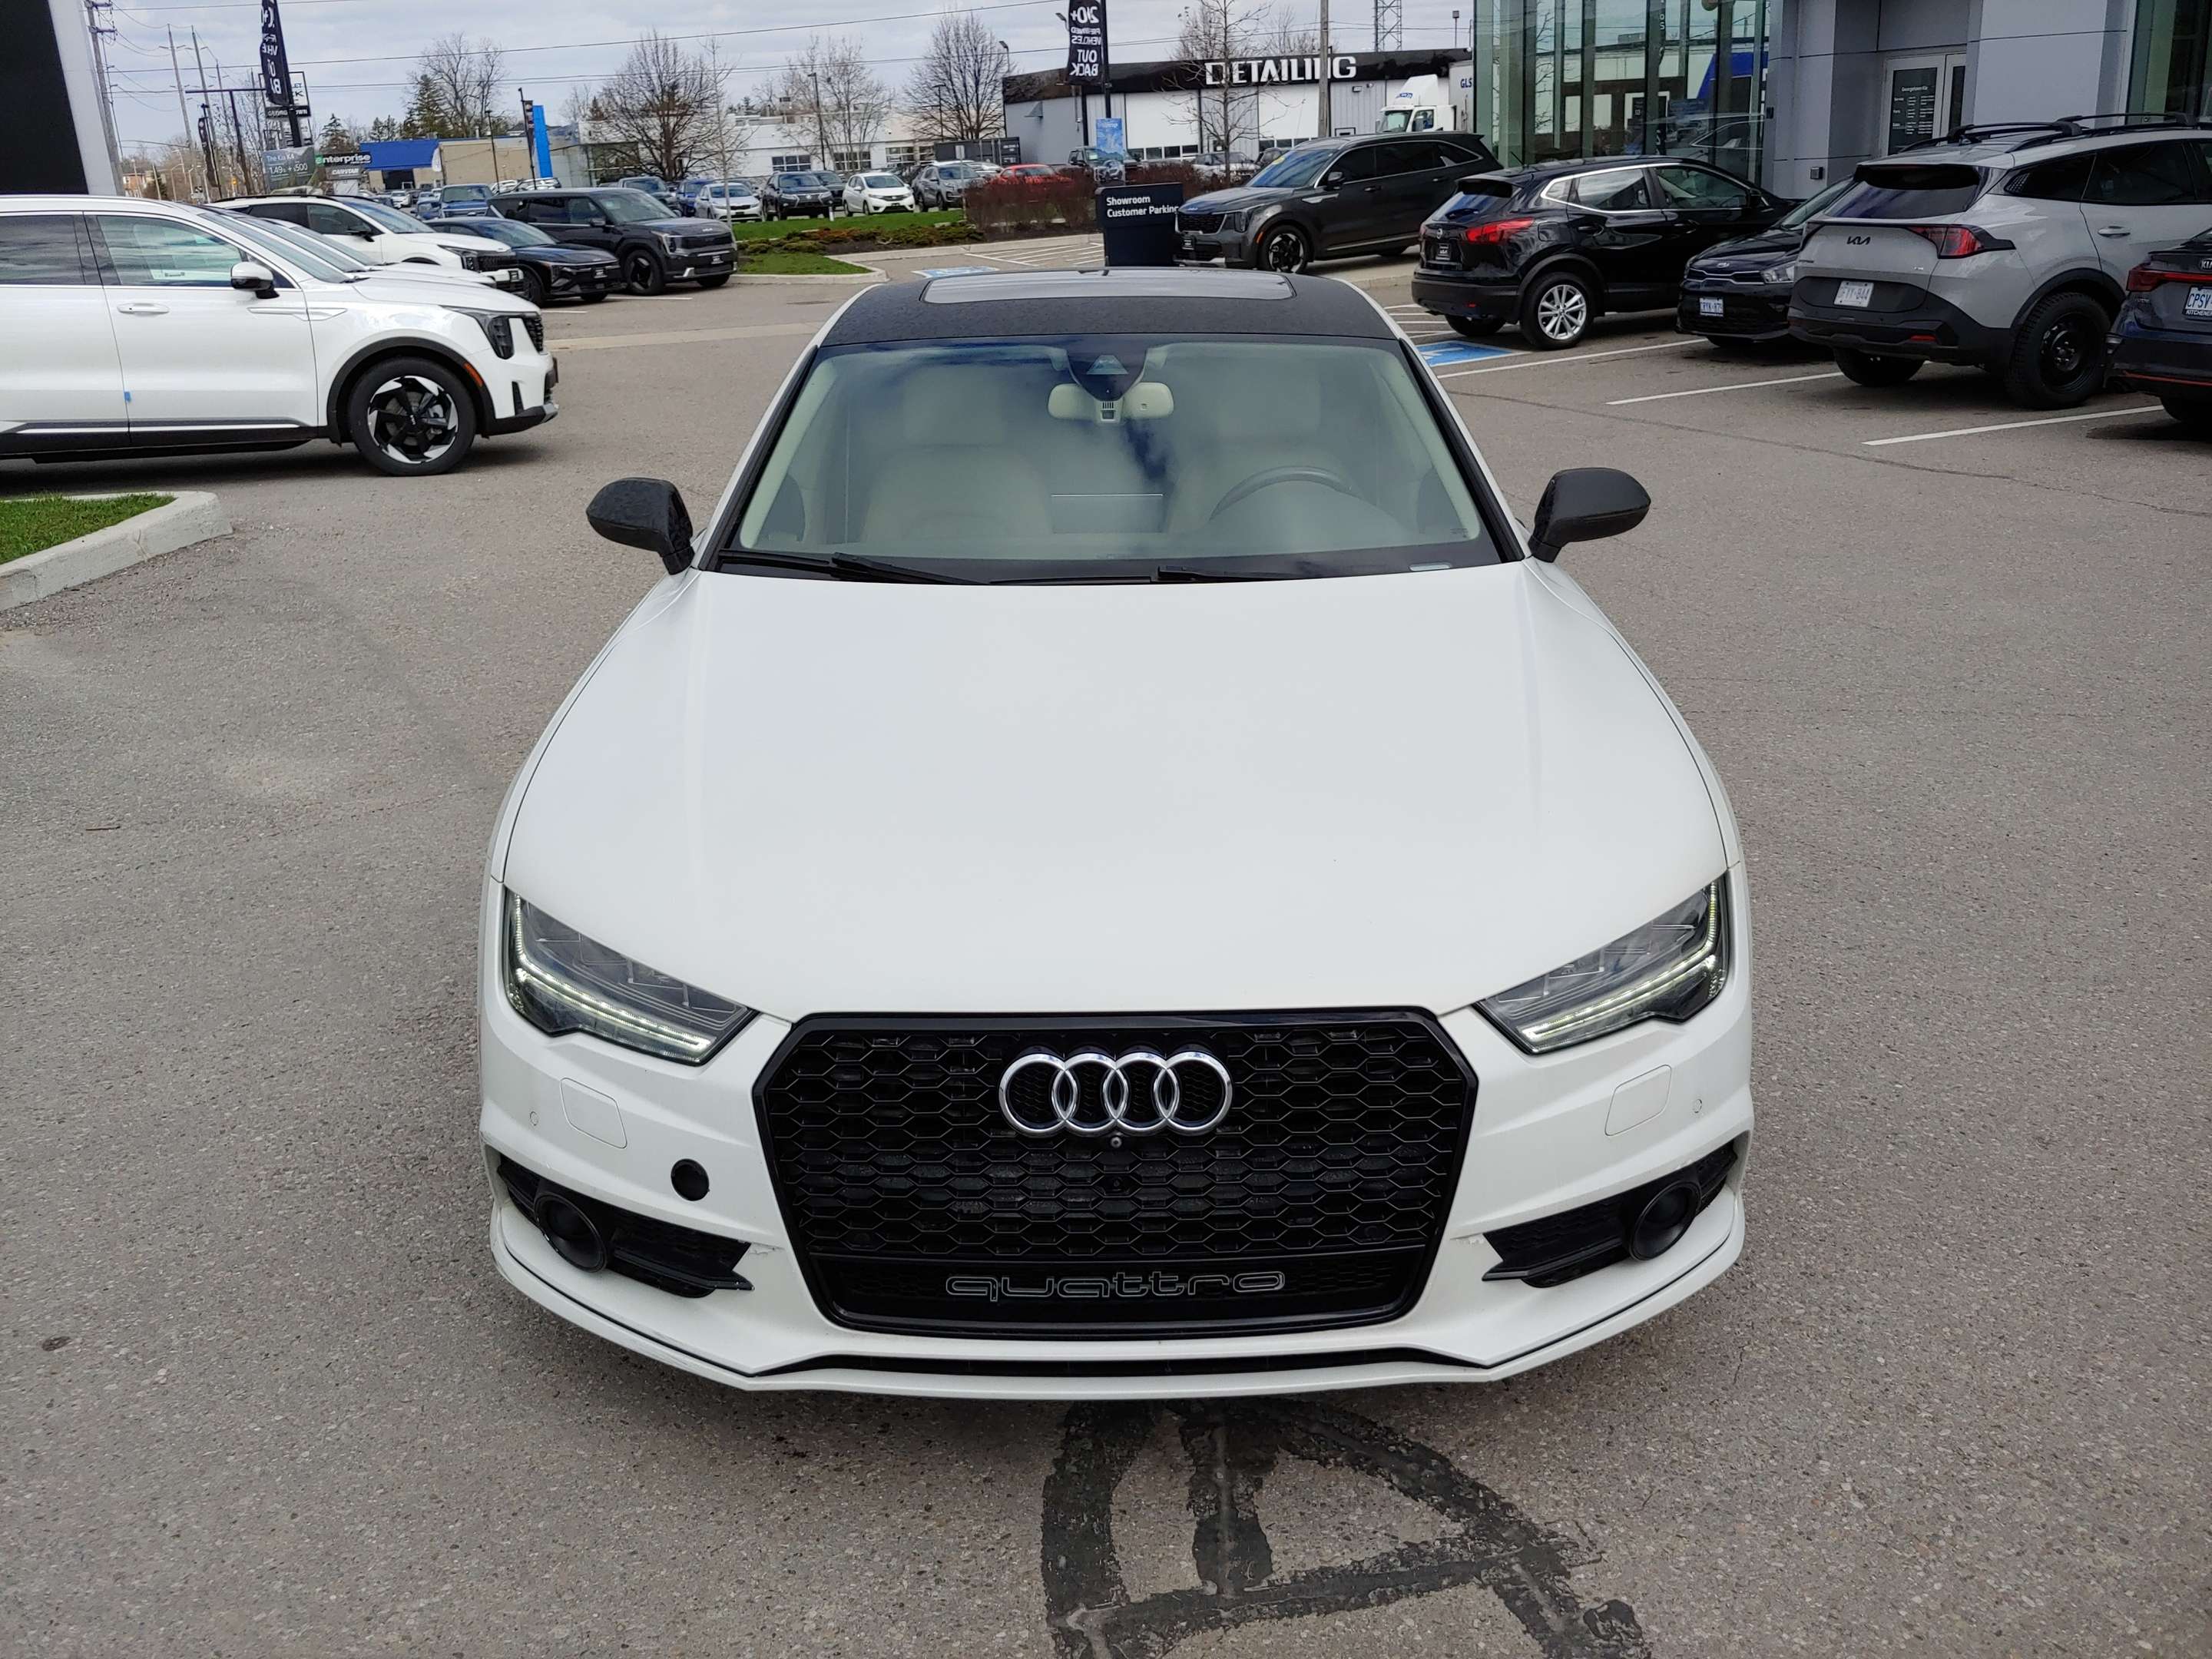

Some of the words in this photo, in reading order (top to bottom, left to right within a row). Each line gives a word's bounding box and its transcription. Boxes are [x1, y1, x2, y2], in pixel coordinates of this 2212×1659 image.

[1204, 56, 1357, 84] DETAILING
[1460, 78, 1472, 88] GLS
[316, 154, 371, 164] enterprise
[1106, 196, 1151, 206] Showroom
[1107, 208, 1147, 217] Customer
[945, 1270, 1286, 1302] quattro
